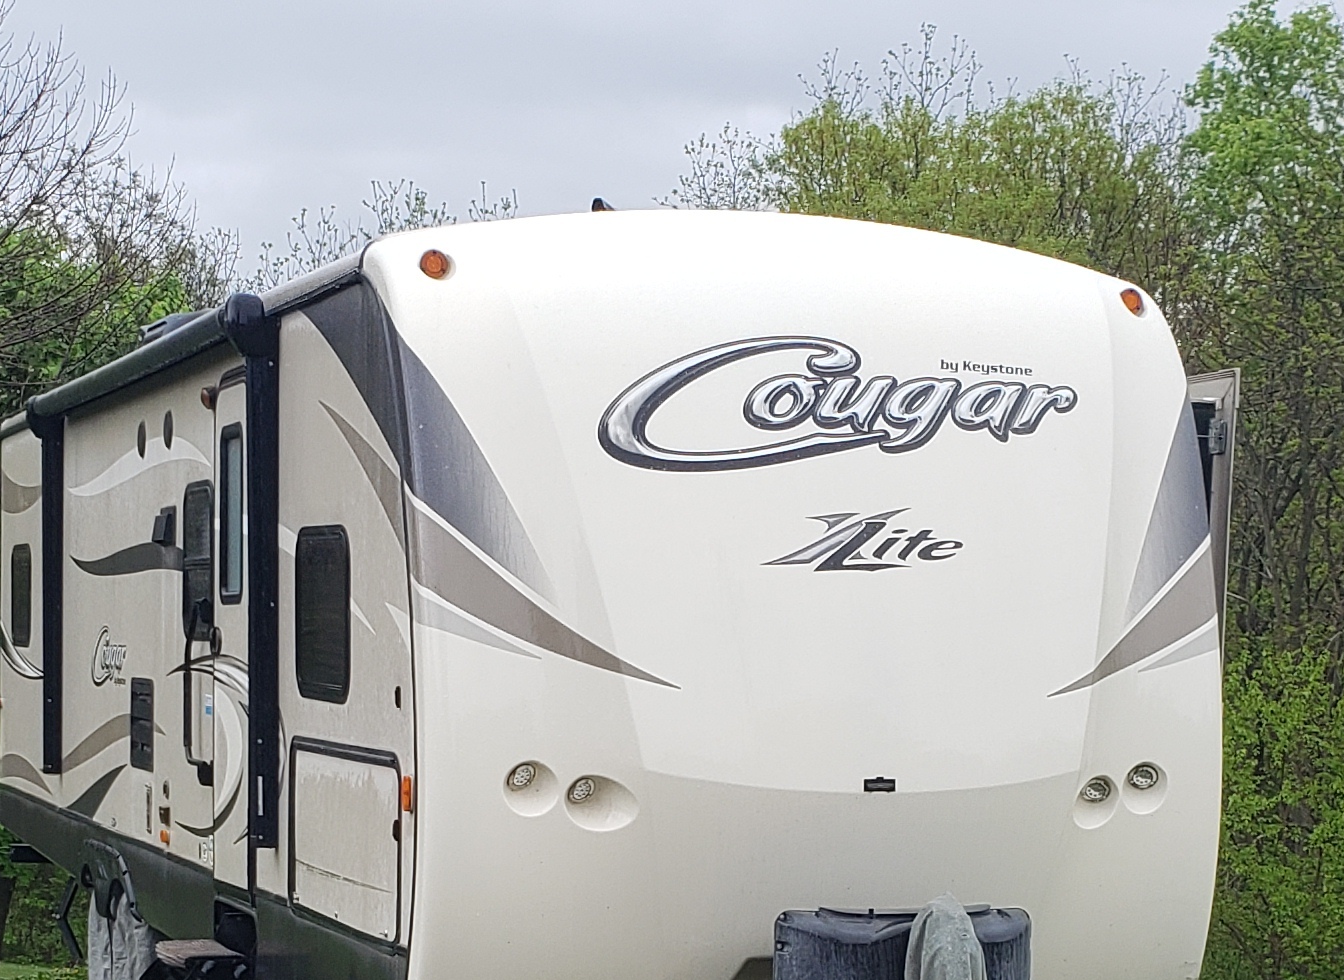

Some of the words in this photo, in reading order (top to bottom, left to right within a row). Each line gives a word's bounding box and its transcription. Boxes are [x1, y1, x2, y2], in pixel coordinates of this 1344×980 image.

[940, 359, 959, 373] by
[962, 360, 1033, 376] Keystone
[598, 335, 1077, 472] Cougar
[91, 625, 127, 686] Cougar
